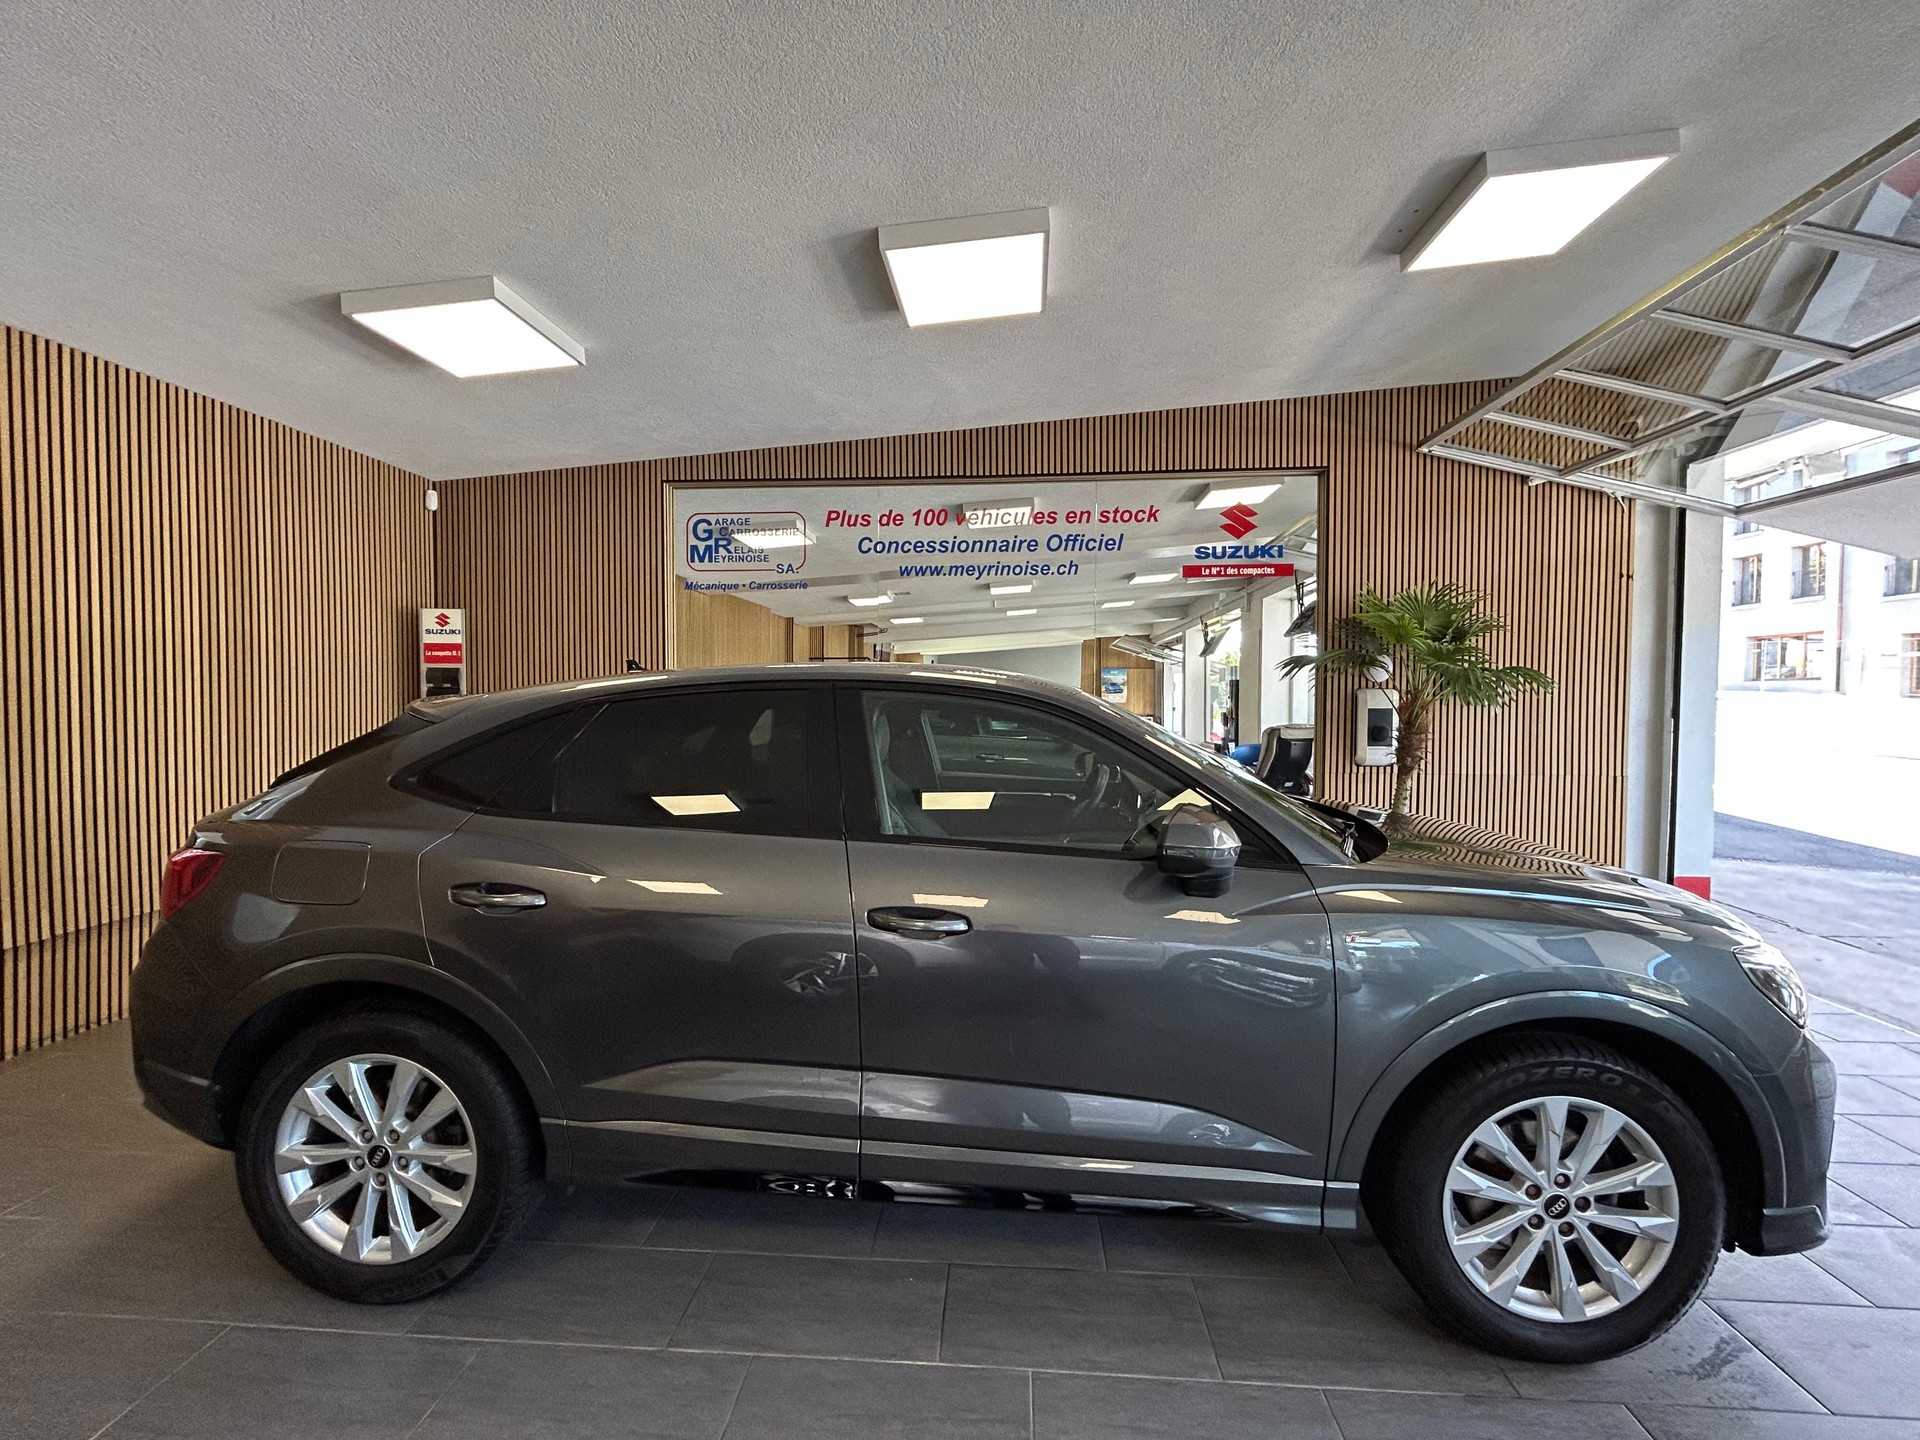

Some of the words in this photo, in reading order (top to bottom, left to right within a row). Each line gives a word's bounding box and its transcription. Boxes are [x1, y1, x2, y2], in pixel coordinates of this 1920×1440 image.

[825, 510, 871, 527] Plus
[879, 509, 904, 526] de
[912, 509, 948, 526] 100
[955, 506, 1058, 526] véhicules
[1065, 510, 1091, 524] en
[1098, 505, 1160, 523] stock
[858, 535, 1039, 554] Concessionnaire
[1046, 533, 1124, 551] Officiel
[1194, 545, 1284, 559] SUZUKI
[899, 560, 1079, 580] www.meyrinoise.ch
[1201, 567, 1210, 575] Le
[1227, 566, 1238, 575] des
[1239, 567, 1275, 576] compactes
[684, 581, 739, 592] Mécanique
[748, 581, 808, 590] Carrosserie
